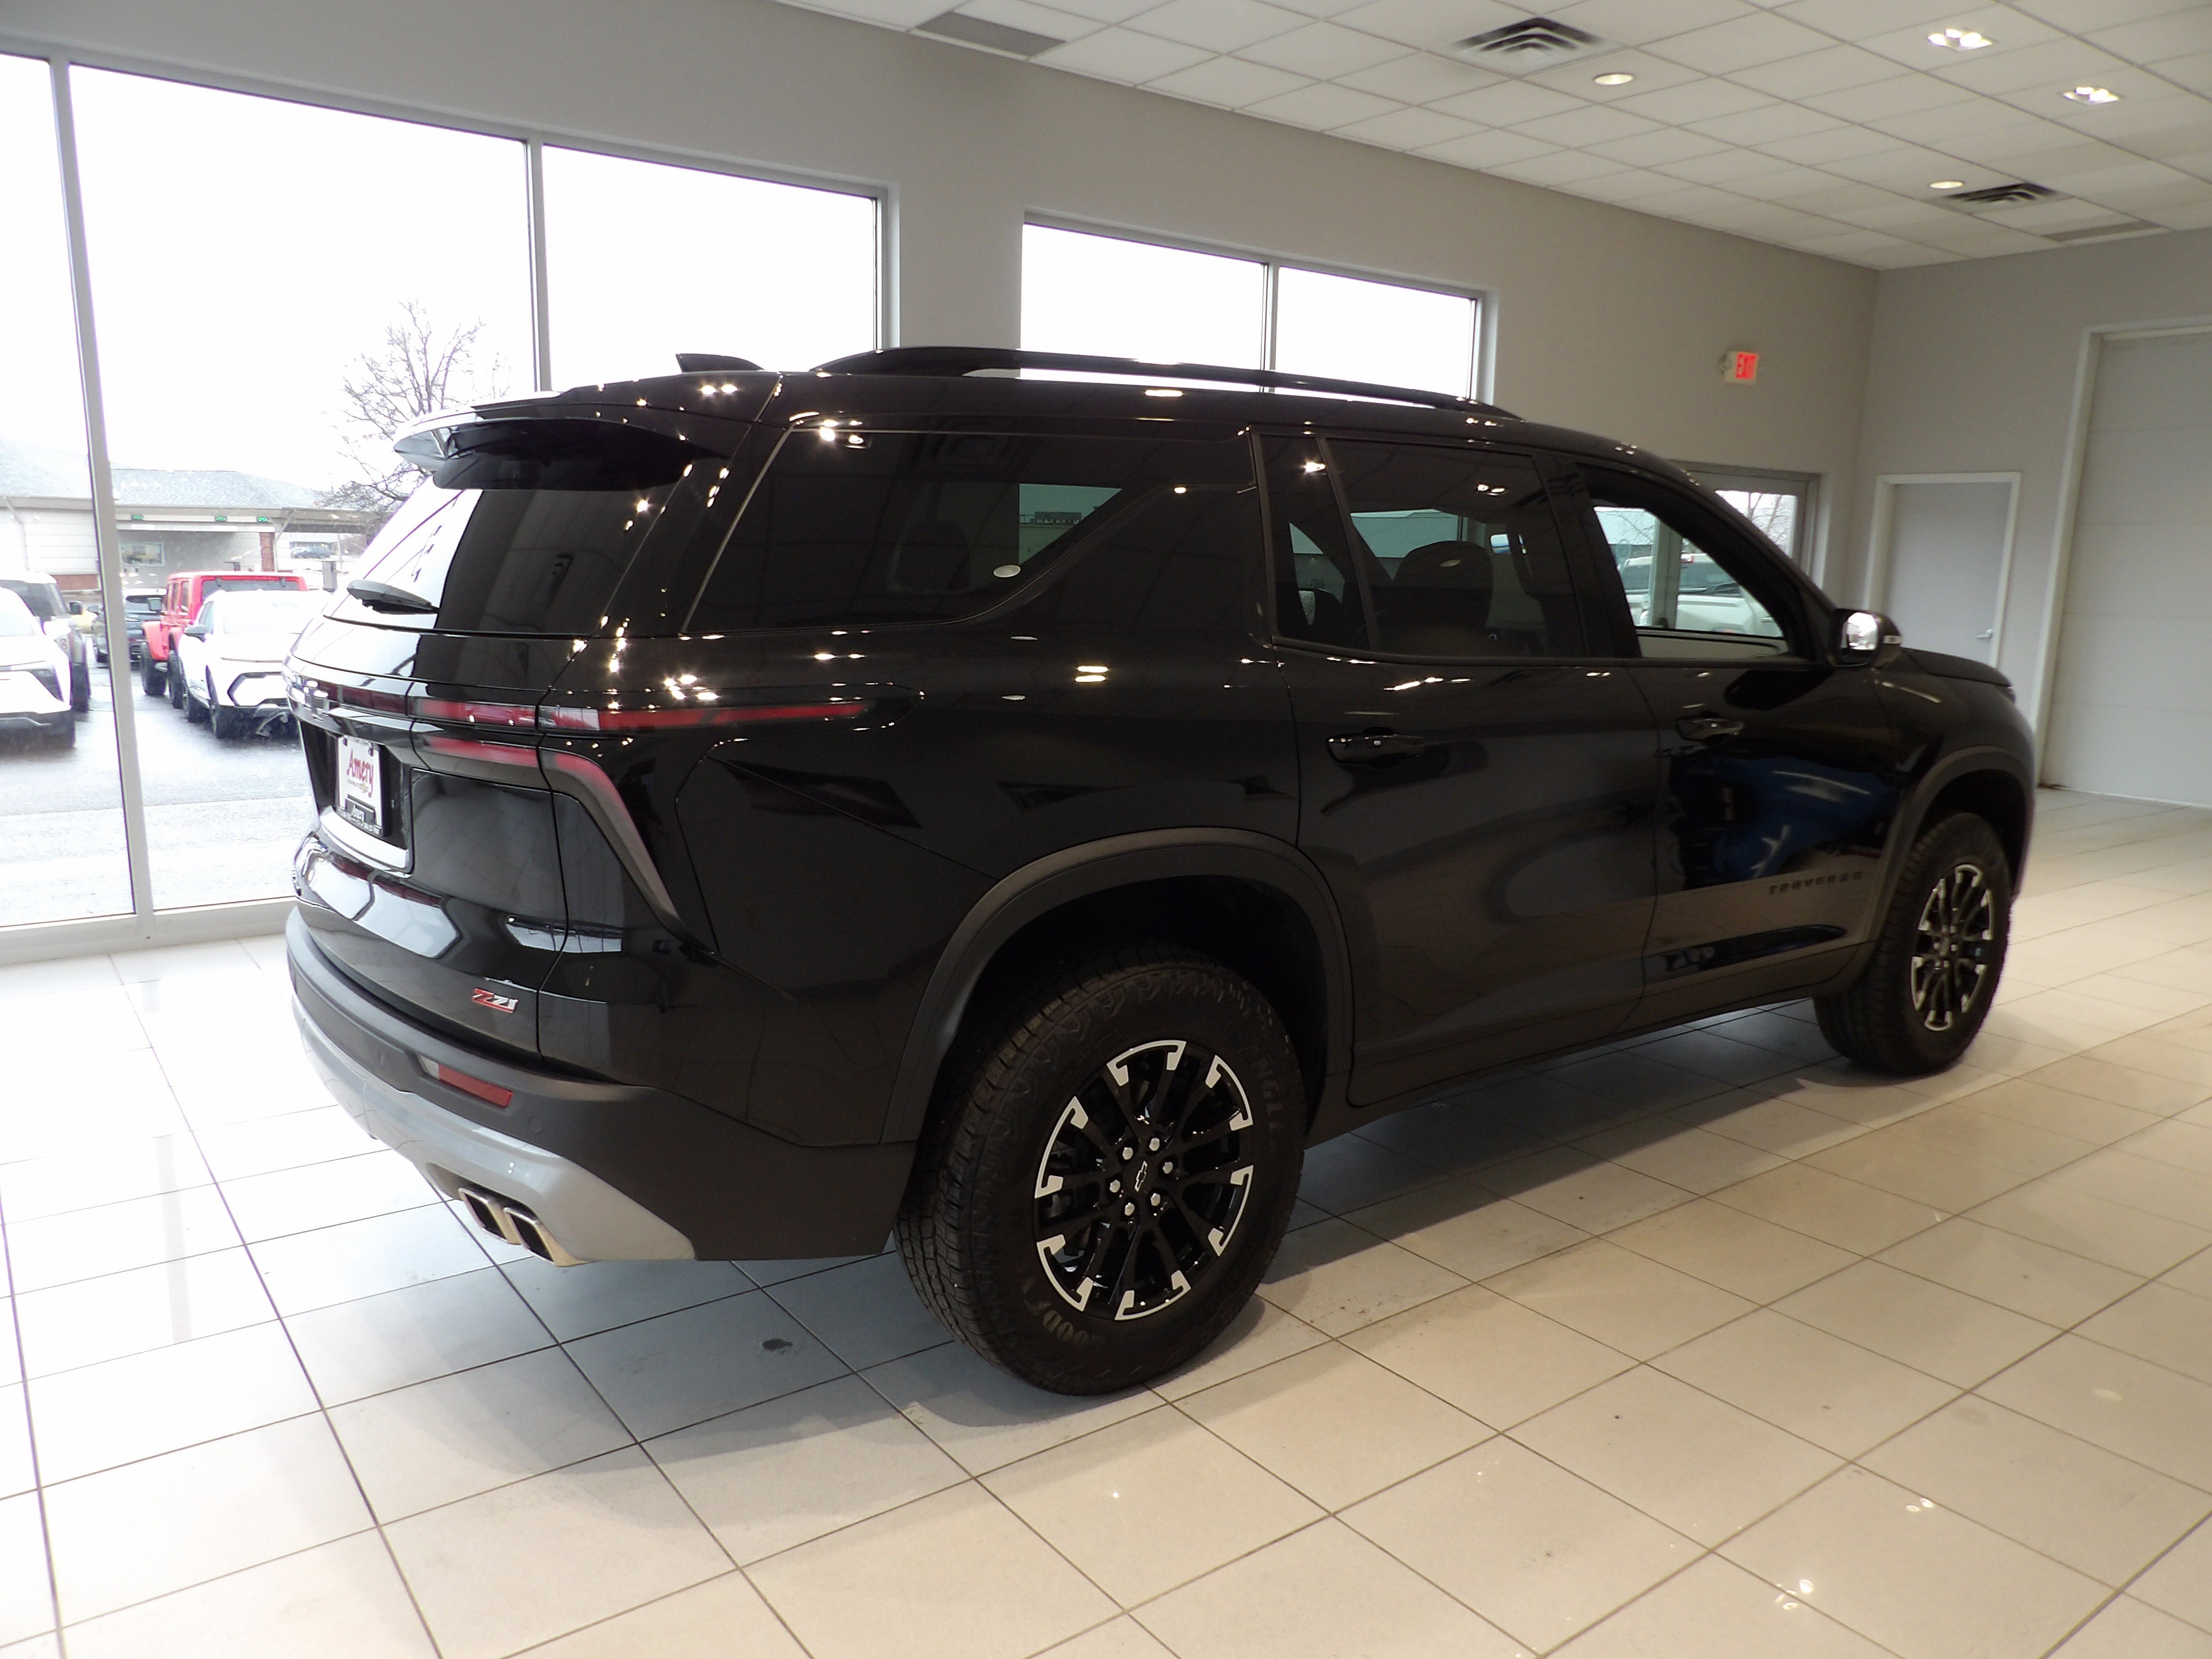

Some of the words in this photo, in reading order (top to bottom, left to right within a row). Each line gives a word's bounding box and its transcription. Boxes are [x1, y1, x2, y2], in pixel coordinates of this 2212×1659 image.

[347, 748, 373, 798] Amery
[1768, 871, 1863, 894] TRAVERSE
[472, 987, 519, 1013] Z71
